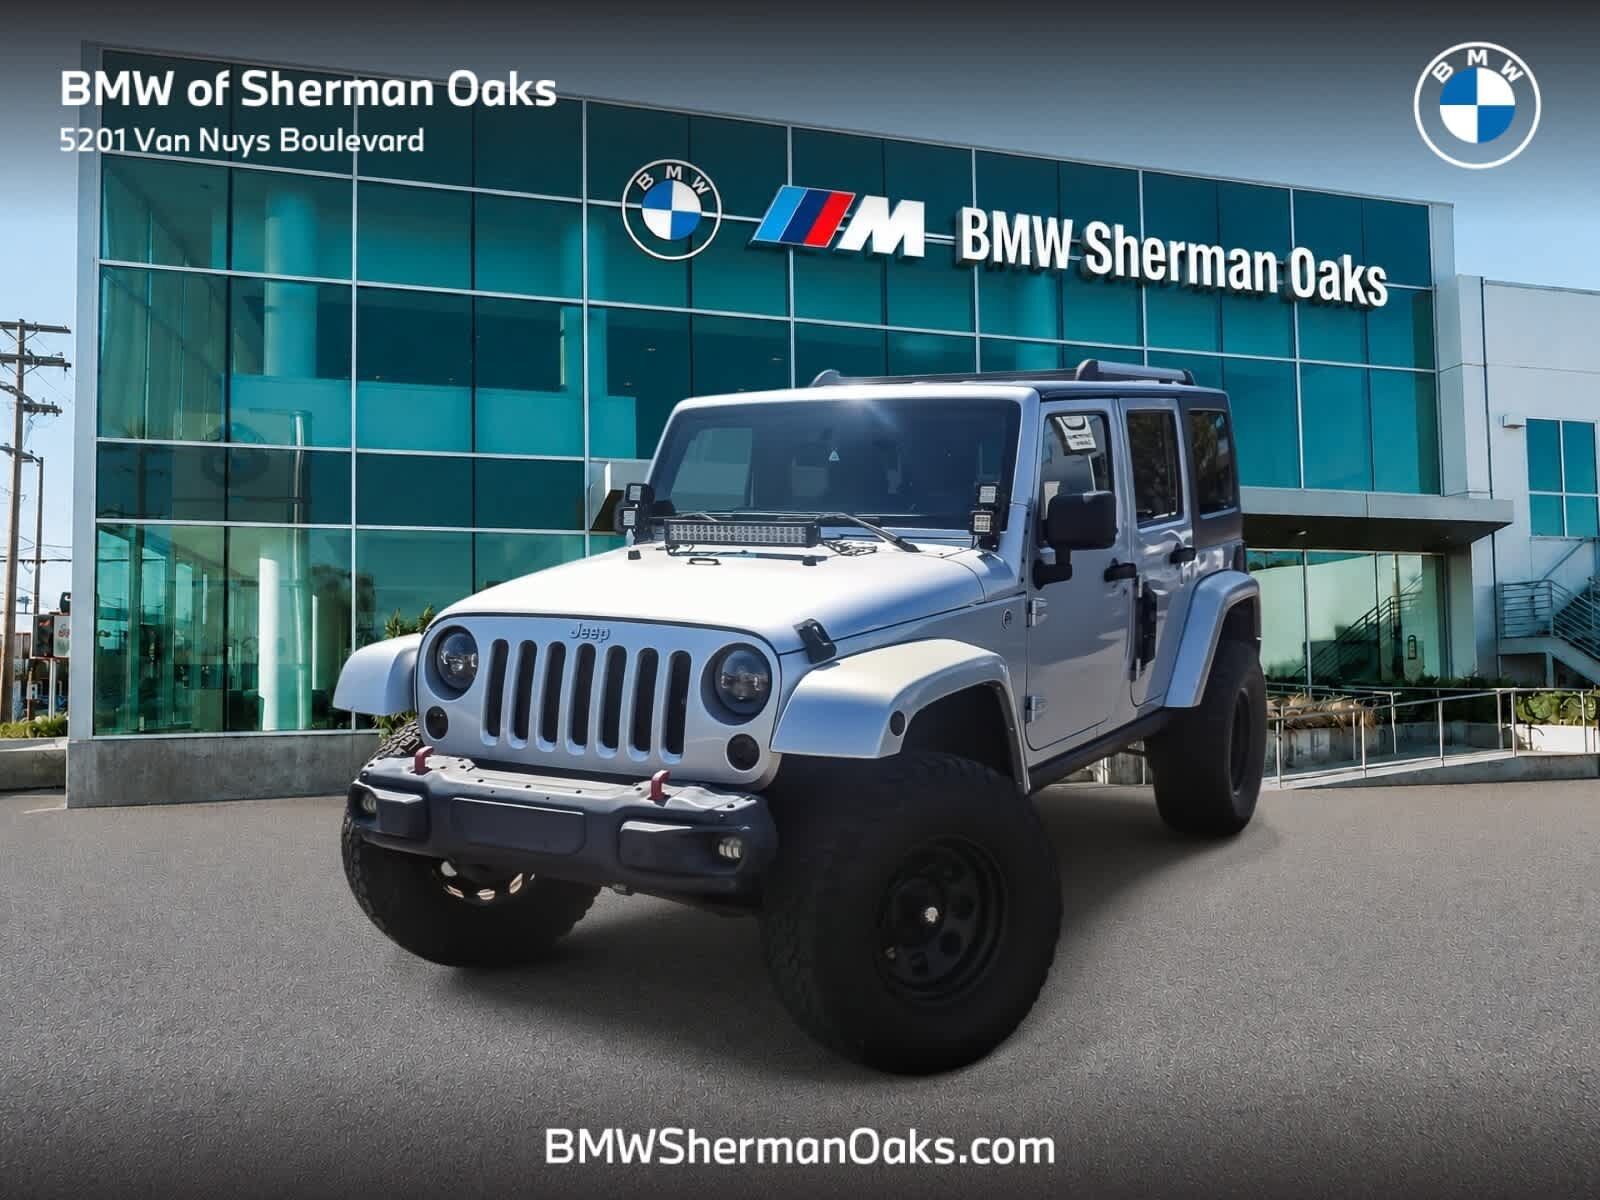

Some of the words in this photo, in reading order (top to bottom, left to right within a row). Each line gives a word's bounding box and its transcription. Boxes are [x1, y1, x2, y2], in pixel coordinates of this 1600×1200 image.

[636, 165, 711, 195] BMW
[961, 206, 1073, 270] BMW
[1086, 217, 1278, 293] Sherman
[1291, 246, 1389, 308] Oaks
[568, 622, 611, 643] Jeep
